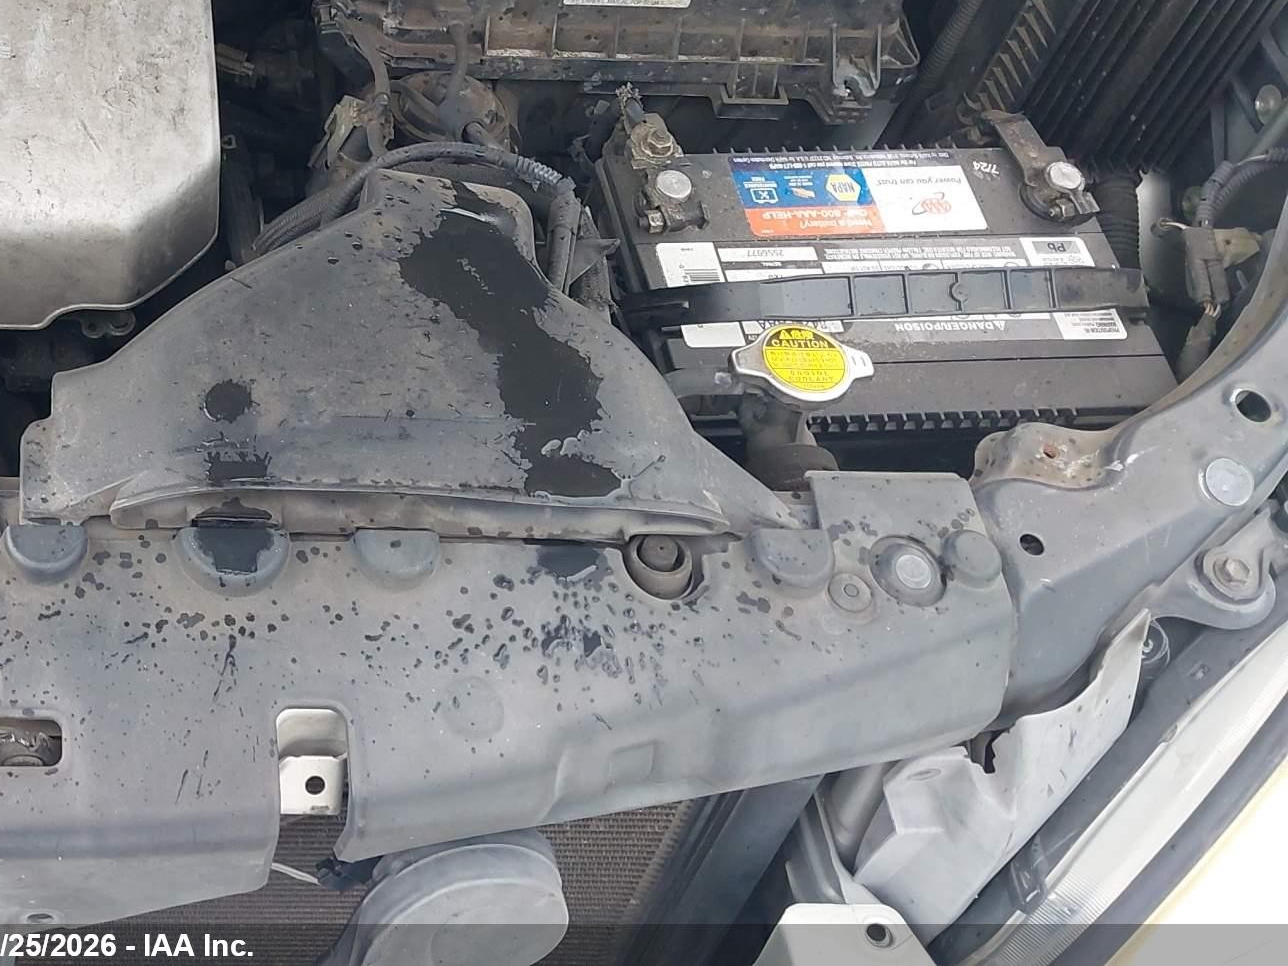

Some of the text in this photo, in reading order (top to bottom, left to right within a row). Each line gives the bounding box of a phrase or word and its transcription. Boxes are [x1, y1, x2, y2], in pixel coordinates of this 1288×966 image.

[899, 177, 915, 185] can
[916, 176, 933, 186] you
[935, 177, 962, 185] Power
[830, 181, 856, 193] NAPA
[1047, 242, 1067, 253] Pb
[894, 321, 994, 332] DANGER/POISON
[771, 339, 829, 348] CAUTION
